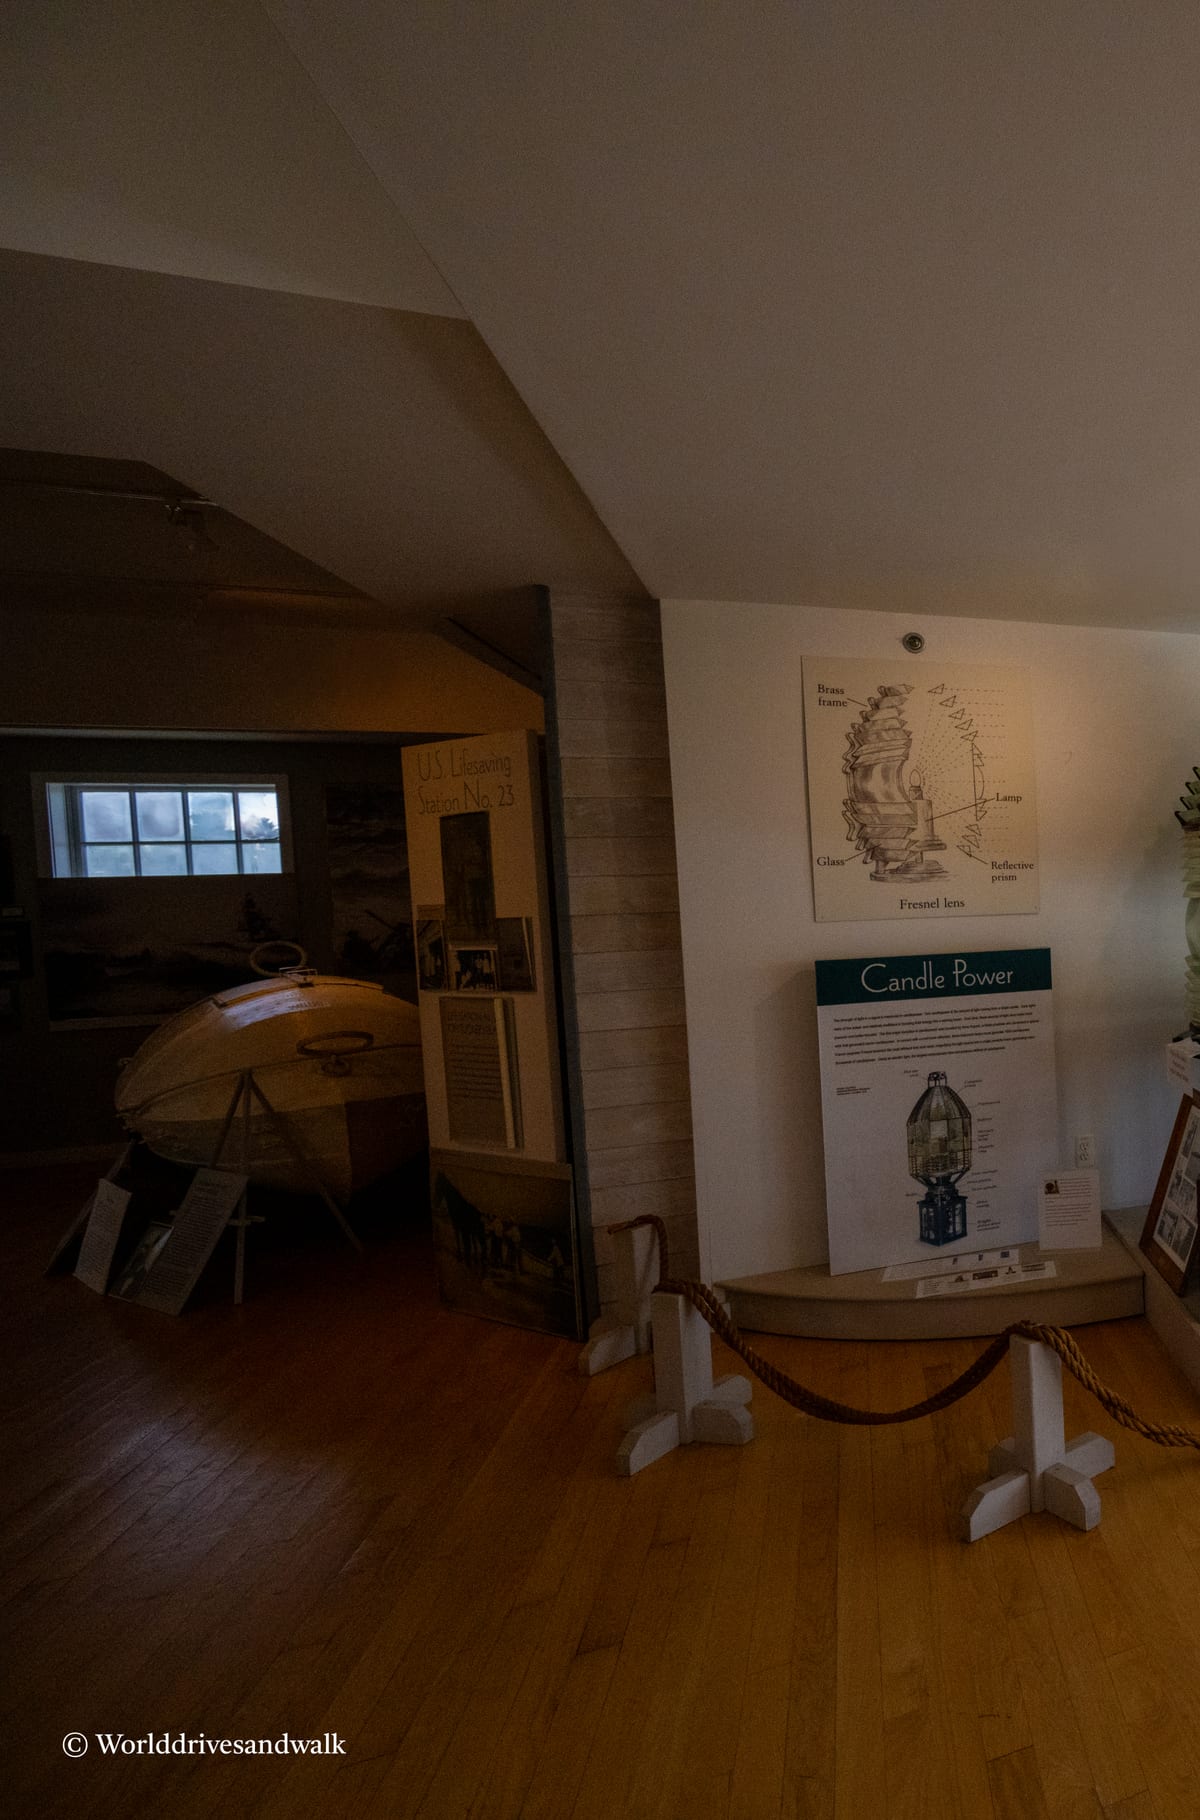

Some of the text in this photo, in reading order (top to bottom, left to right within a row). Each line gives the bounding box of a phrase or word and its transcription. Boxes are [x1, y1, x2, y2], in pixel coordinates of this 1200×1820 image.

[817, 684, 844, 695] Brass
[818, 697, 848, 707] frame
[417, 748, 511, 782] U.S. Lifesaving
[417, 778, 515, 815] Station No. 23
[996, 792, 1022, 804] Lamp
[817, 856, 845, 866] Glass
[991, 860, 1035, 870] Reflective
[992, 872, 1017, 883] prism
[900, 898, 965, 909] Fresnel lens
[861, 959, 1014, 993] Candle Power
